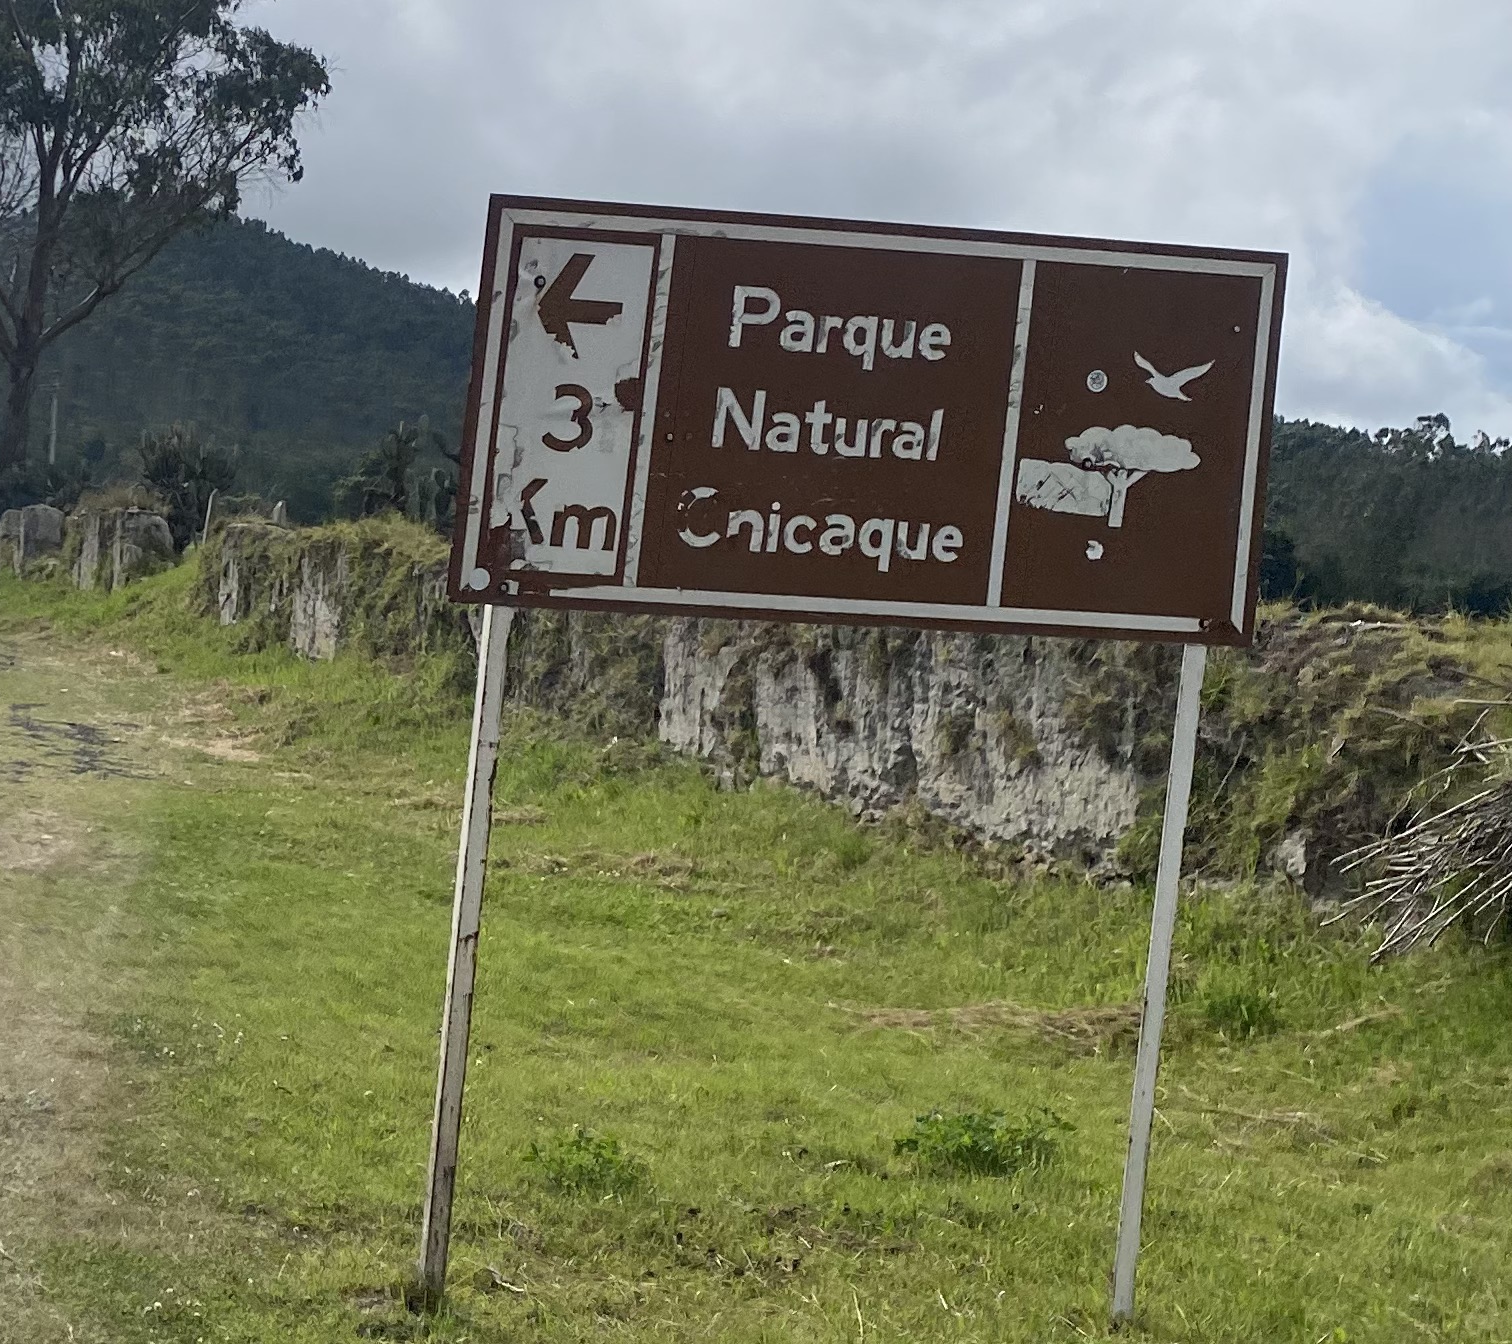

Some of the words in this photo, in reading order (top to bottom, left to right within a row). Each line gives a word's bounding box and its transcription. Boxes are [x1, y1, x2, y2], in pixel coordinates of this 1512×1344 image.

[728, 285, 952, 371] Parque
[541, 383, 593, 452] 3
[711, 387, 944, 461] Natural
